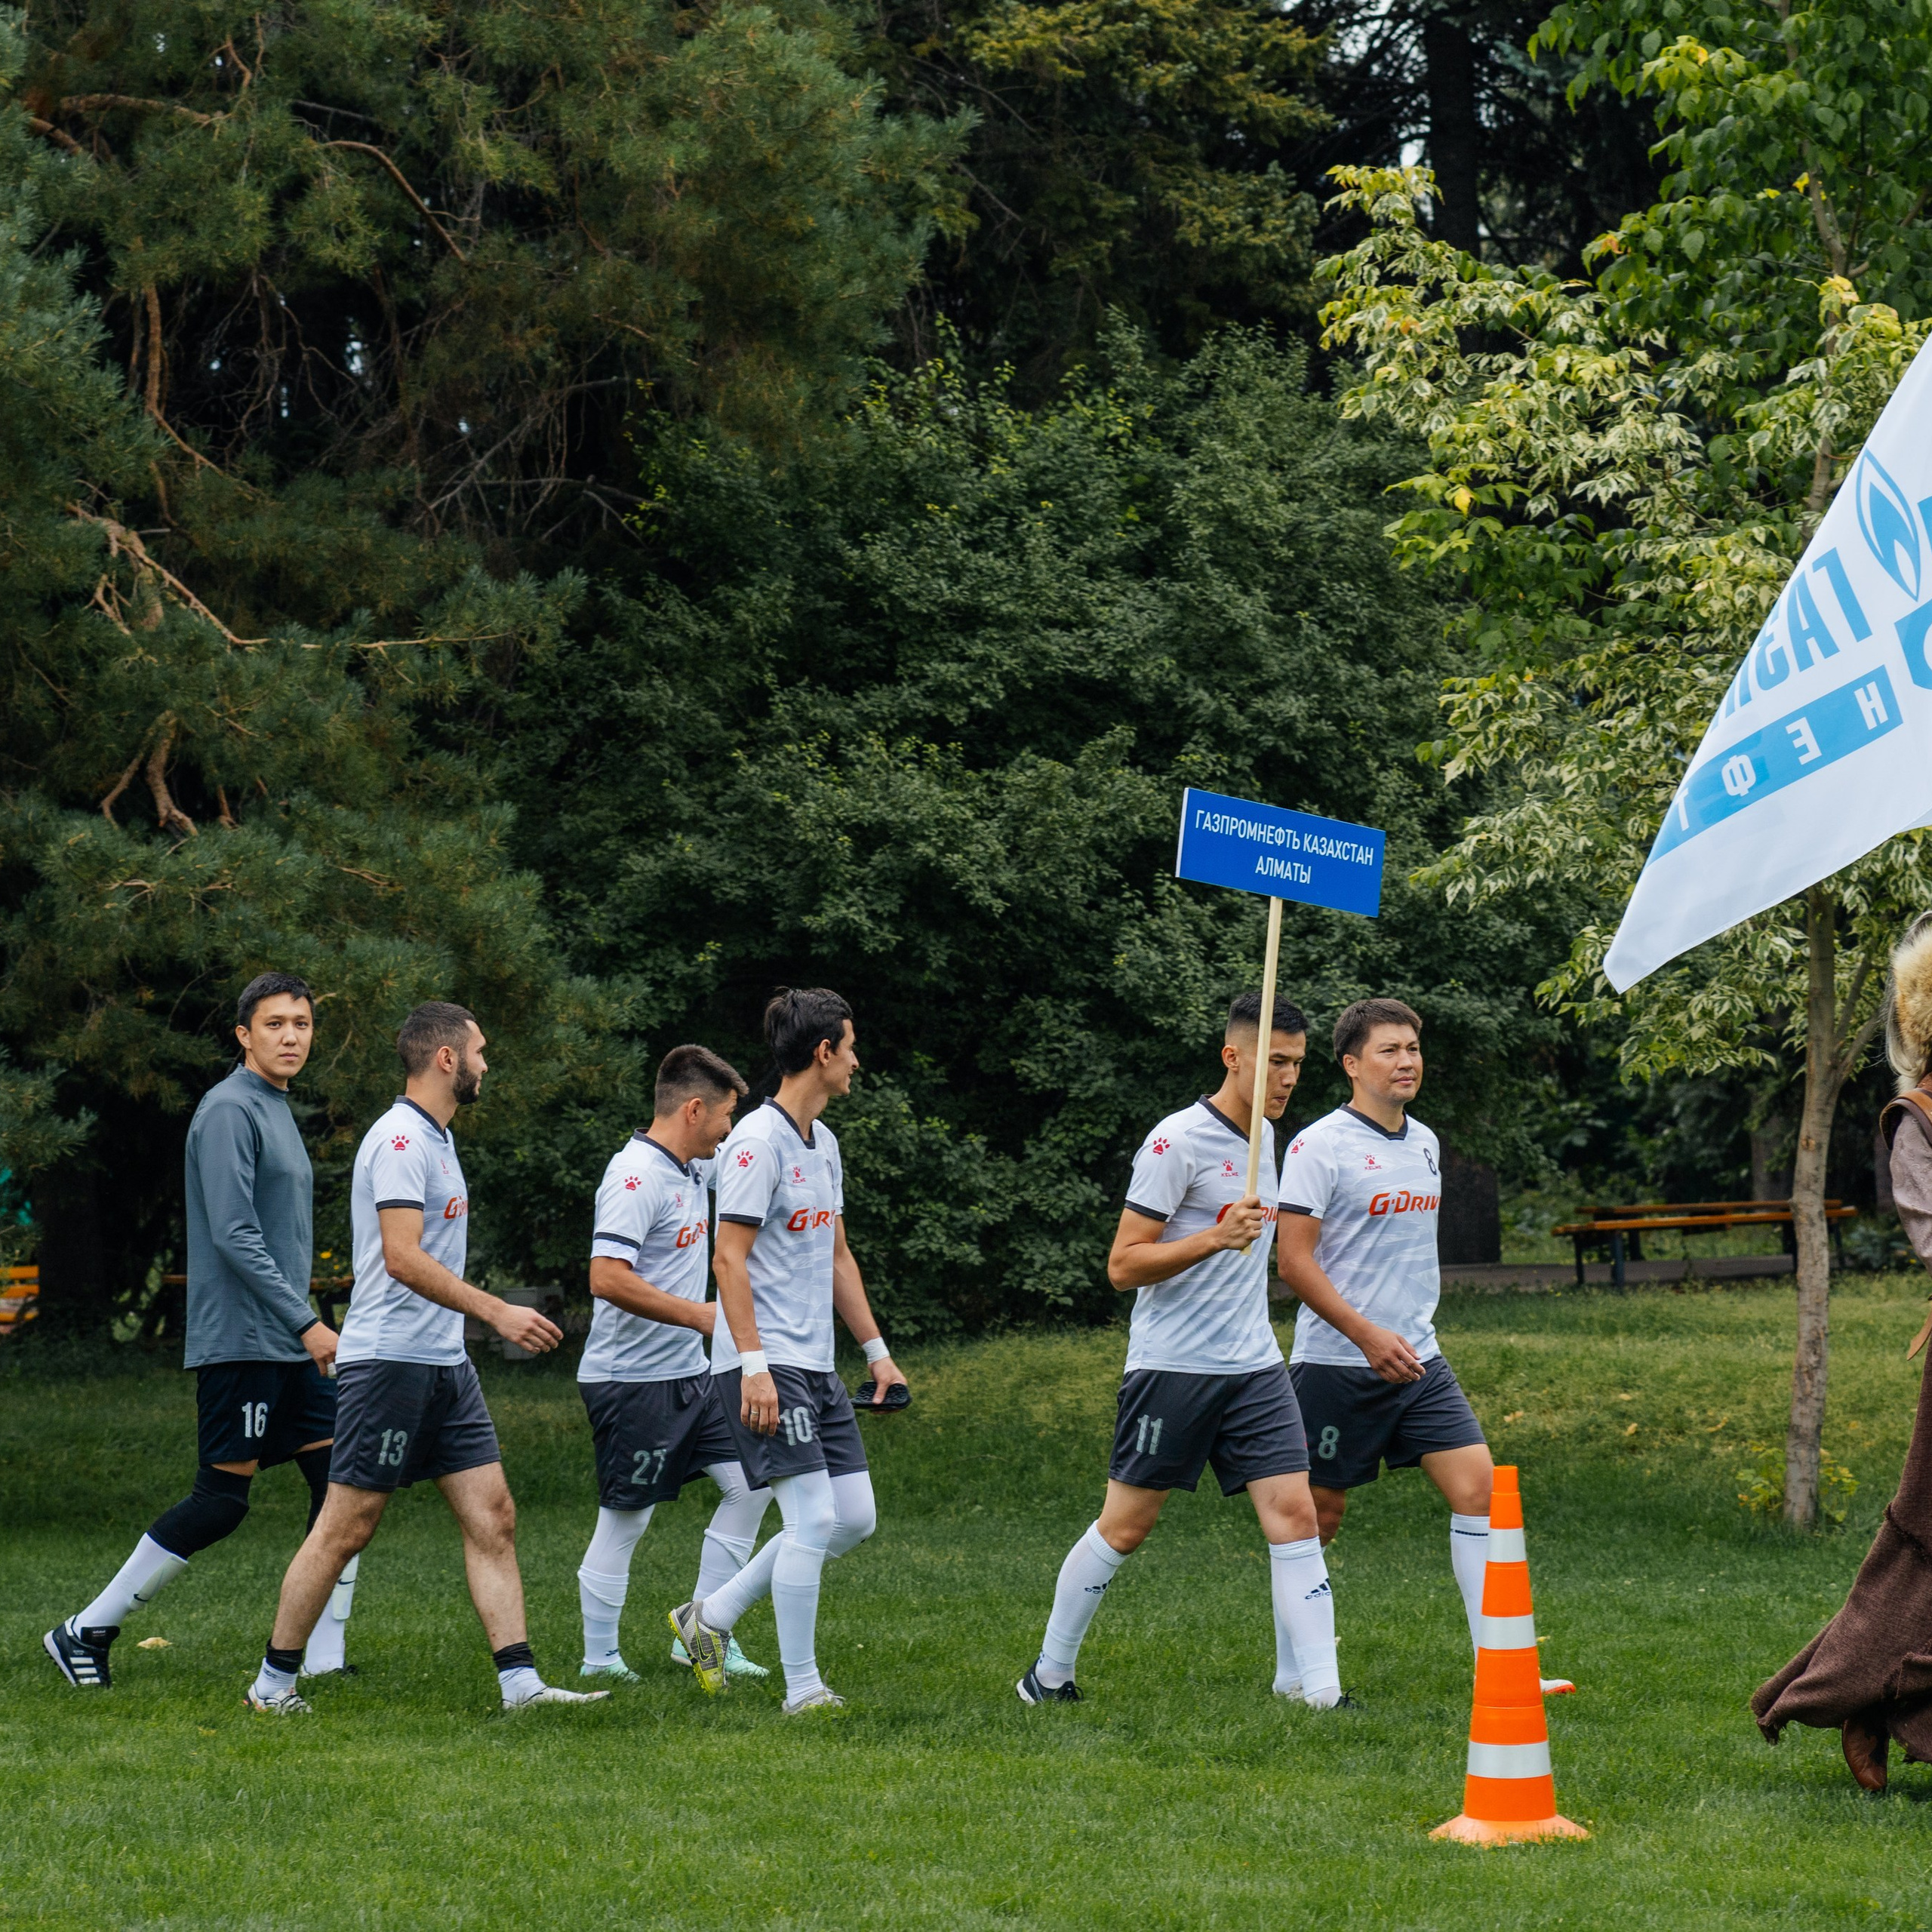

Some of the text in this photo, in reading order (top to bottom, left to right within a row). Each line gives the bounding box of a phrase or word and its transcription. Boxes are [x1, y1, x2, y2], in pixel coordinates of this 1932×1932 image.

[1195, 810, 1374, 866] ГАЗПРОМНЕФТЬ КАЗАХСТАН
[1255, 856, 1312, 884] АЛМАТЫ
[1423, 1148, 1437, 1175] 8
[242, 1401, 269, 1438] 16
[780, 1407, 814, 1446] 10
[1137, 1414, 1164, 1455] 11
[379, 1428, 408, 1466] 13
[1320, 1426, 1340, 1460] 8
[632, 1449, 666, 1485] 27
